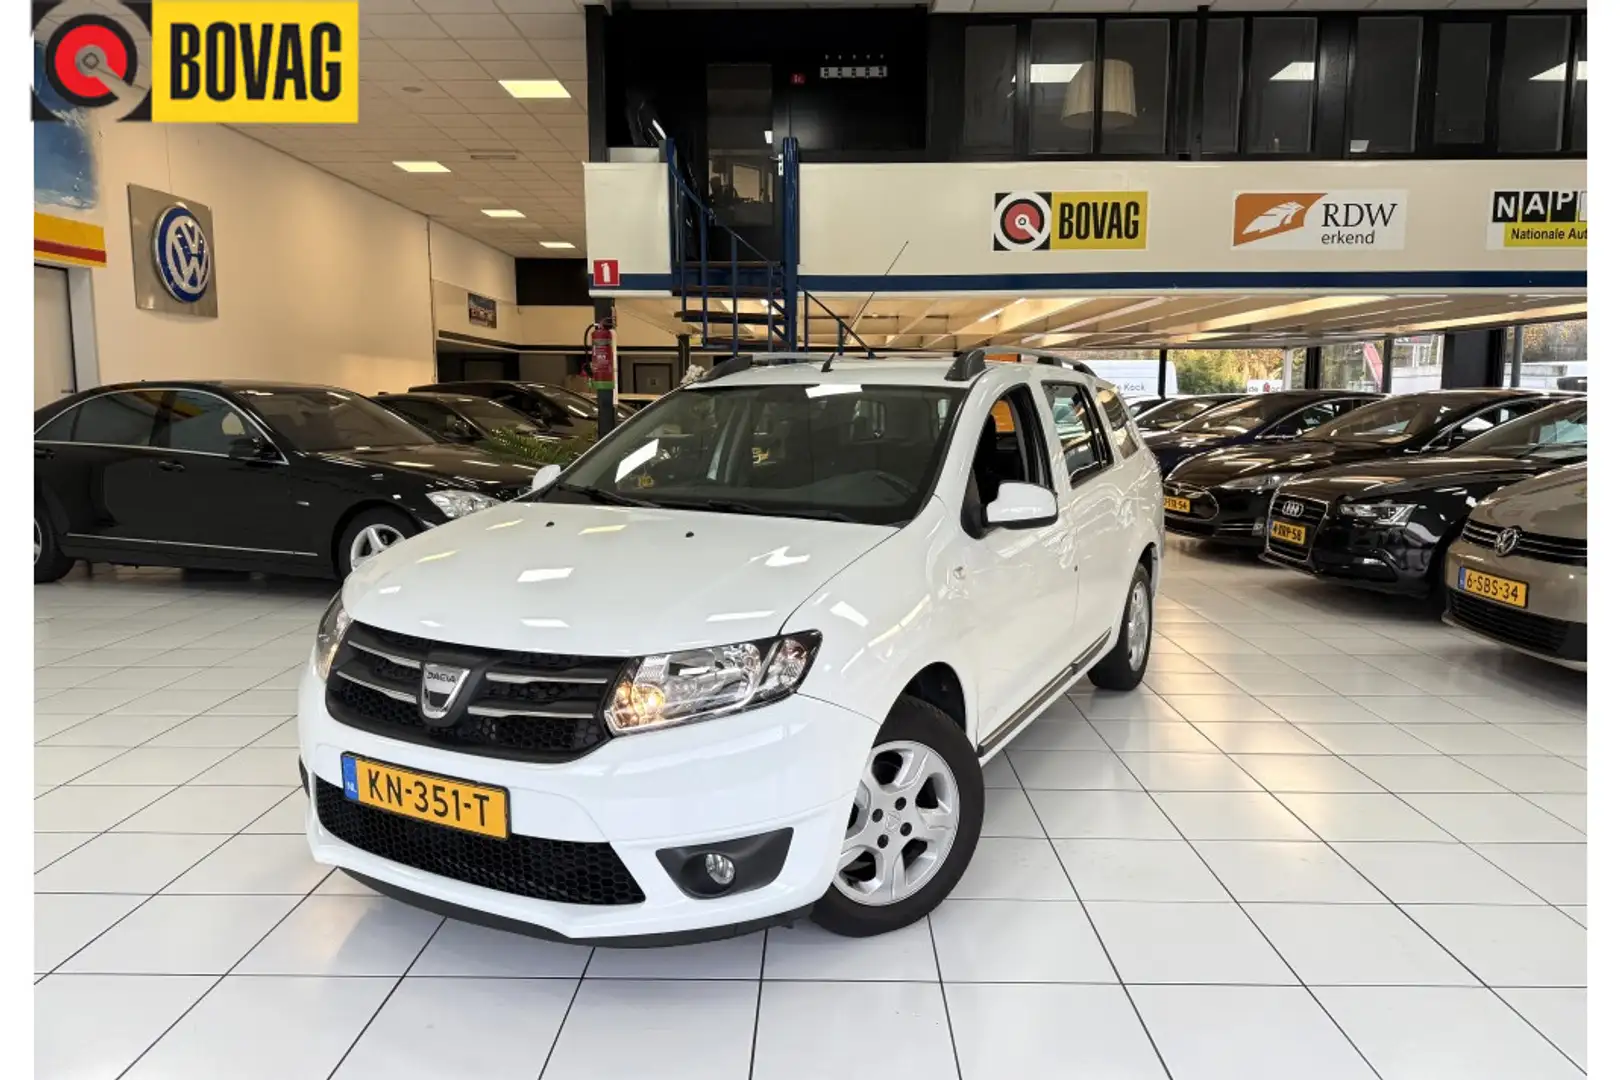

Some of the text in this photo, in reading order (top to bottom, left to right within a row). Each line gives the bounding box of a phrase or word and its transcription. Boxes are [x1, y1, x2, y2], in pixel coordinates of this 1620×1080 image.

[1321, 203, 1398, 227] RDW
[1497, 192, 1574, 218] NAP
[1058, 201, 1140, 240] BOVAG
[1511, 227, 1565, 240] Nationale
[1321, 230, 1375, 245] erkend
[1466, 573, 1519, 602] 6-SBS-34
[368, 768, 490, 826] KN-351-T
